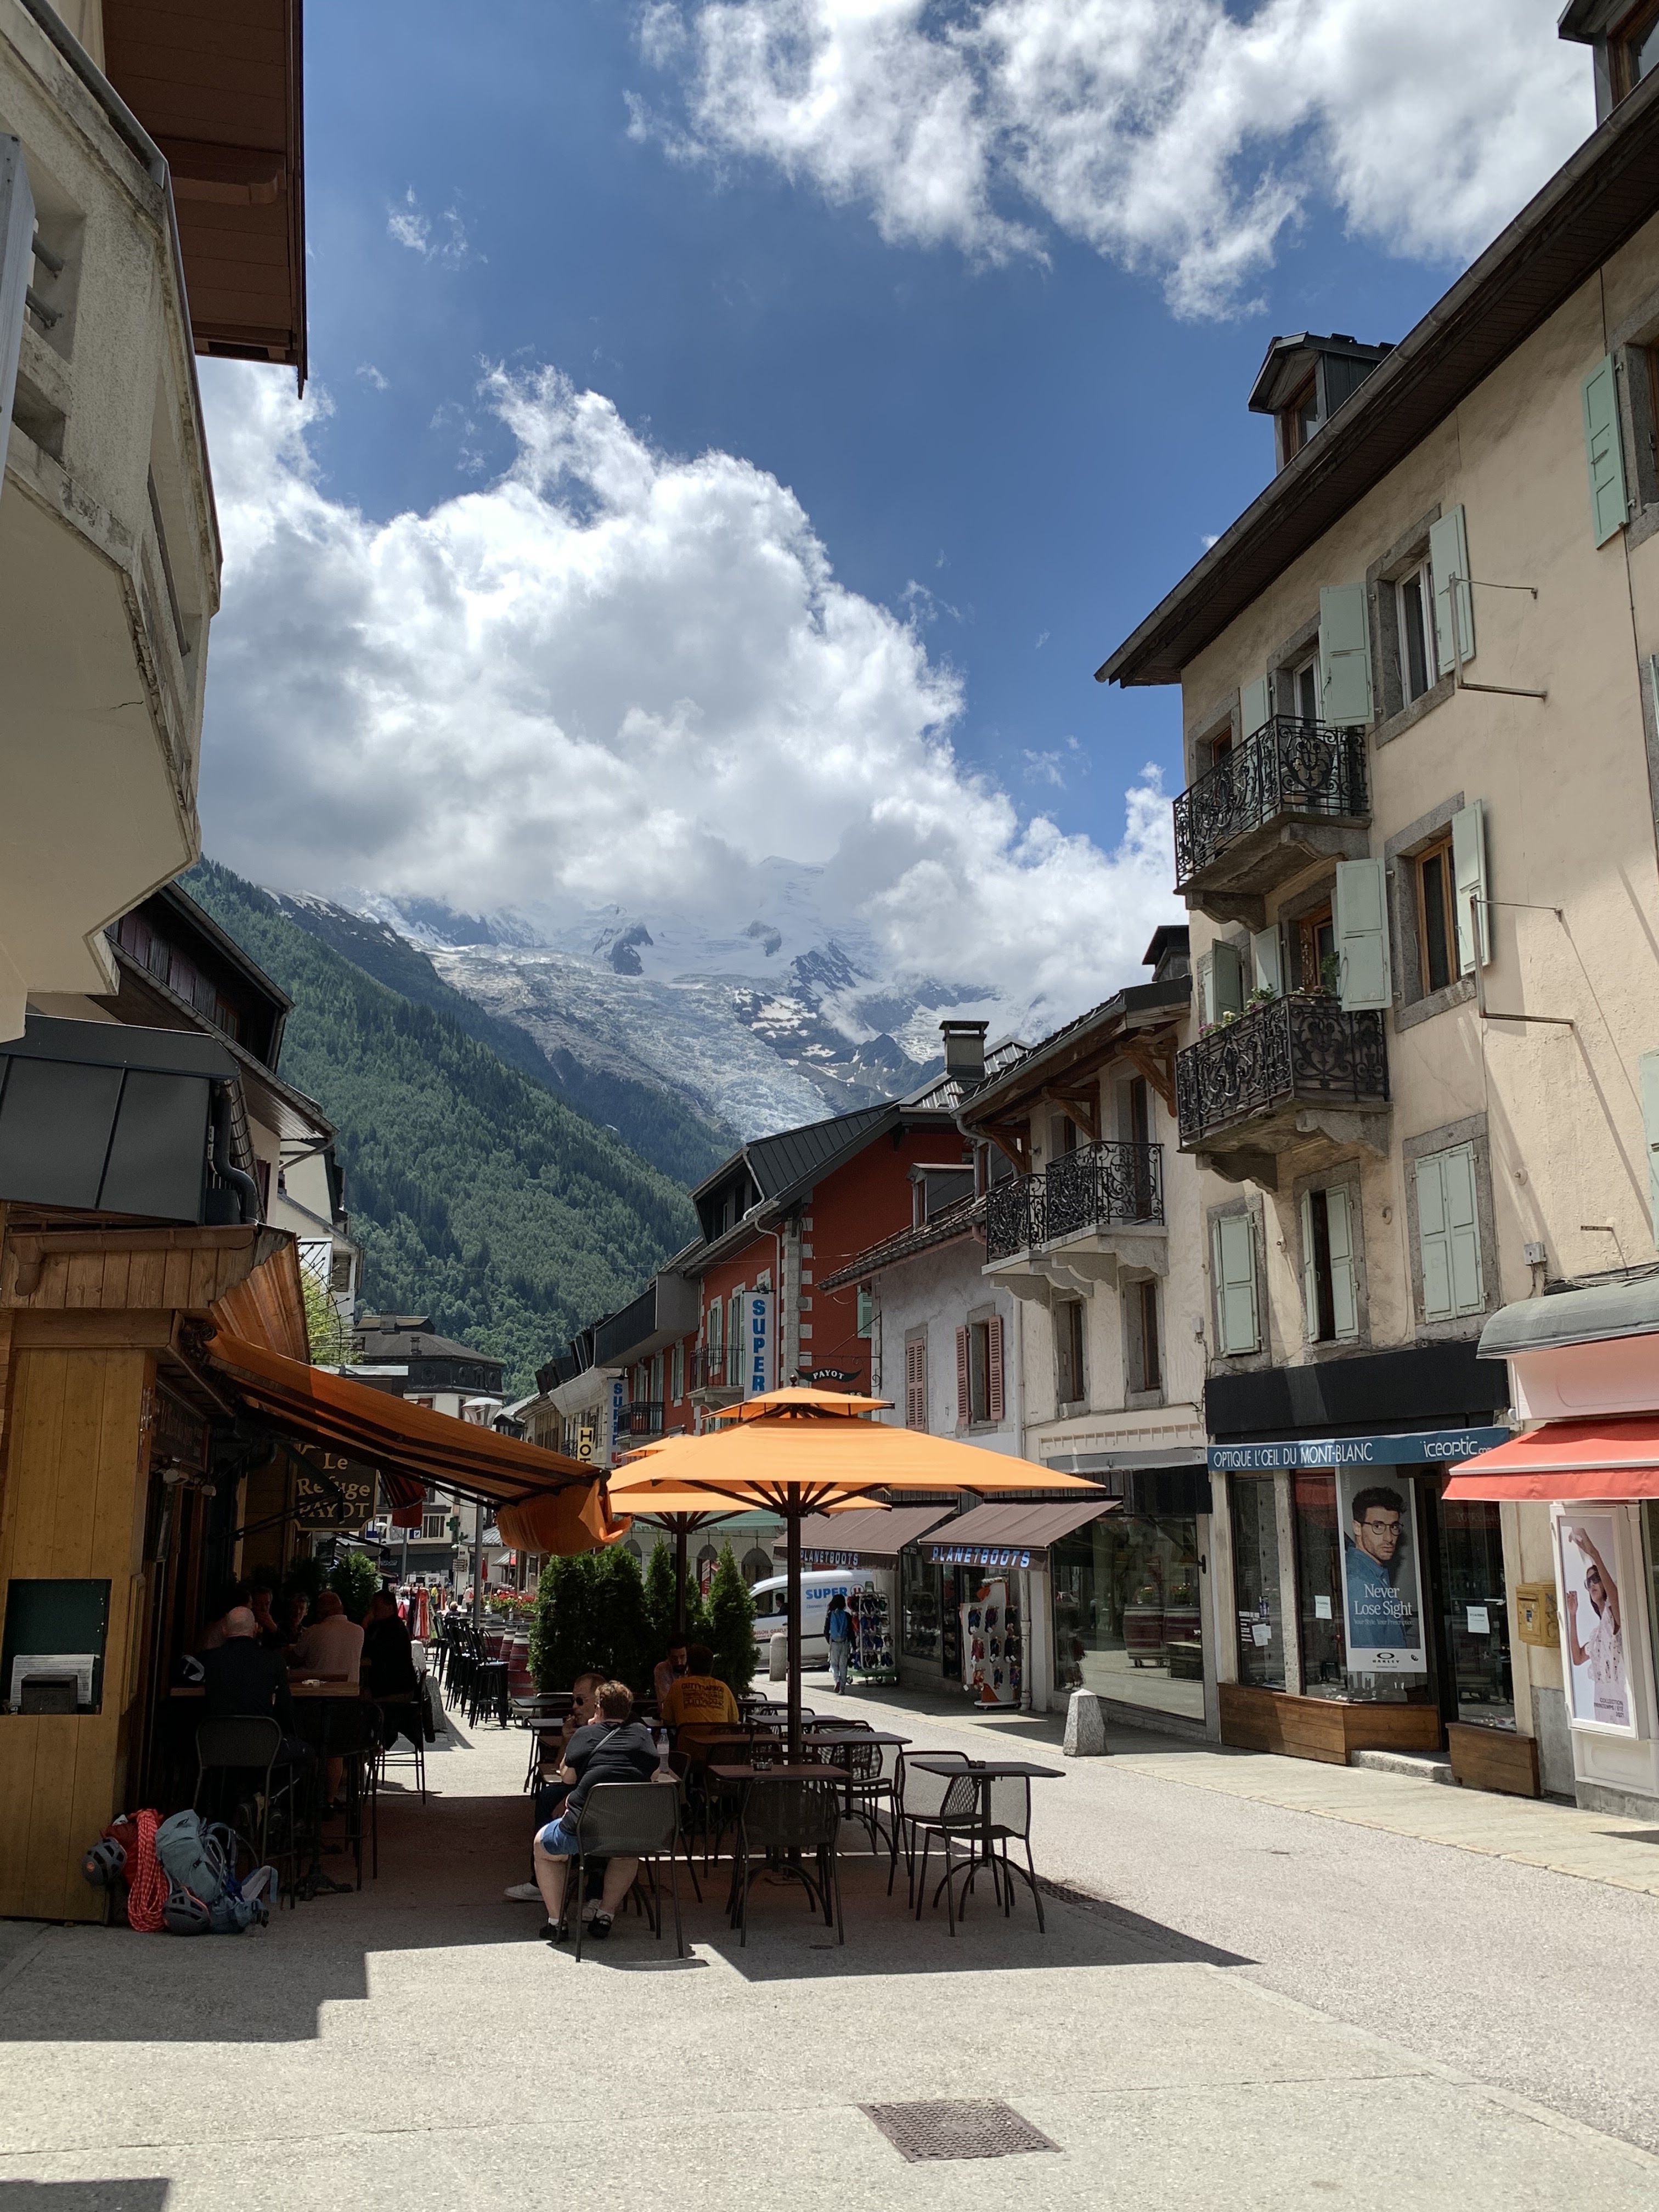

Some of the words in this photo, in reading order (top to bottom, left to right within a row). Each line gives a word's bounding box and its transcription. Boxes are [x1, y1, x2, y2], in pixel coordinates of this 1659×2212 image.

[752, 1299, 766, 1391] SUPER
[812, 1369, 845, 1380] PAYOT
[323, 1453, 348, 1470] Le
[1214, 1449, 1252, 1468] OPTIQUE
[1255, 1448, 1280, 1466] L'ŒIL
[1283, 1447, 1297, 1465] DU
[1300, 1442, 1373, 1464] MONT-BLANC
[805, 1587, 848, 1600] SUPER
[1364, 1584, 1400, 1598] Never
[1354, 1600, 1381, 1615] Lose
[1383, 1600, 1413, 1618] Sight
